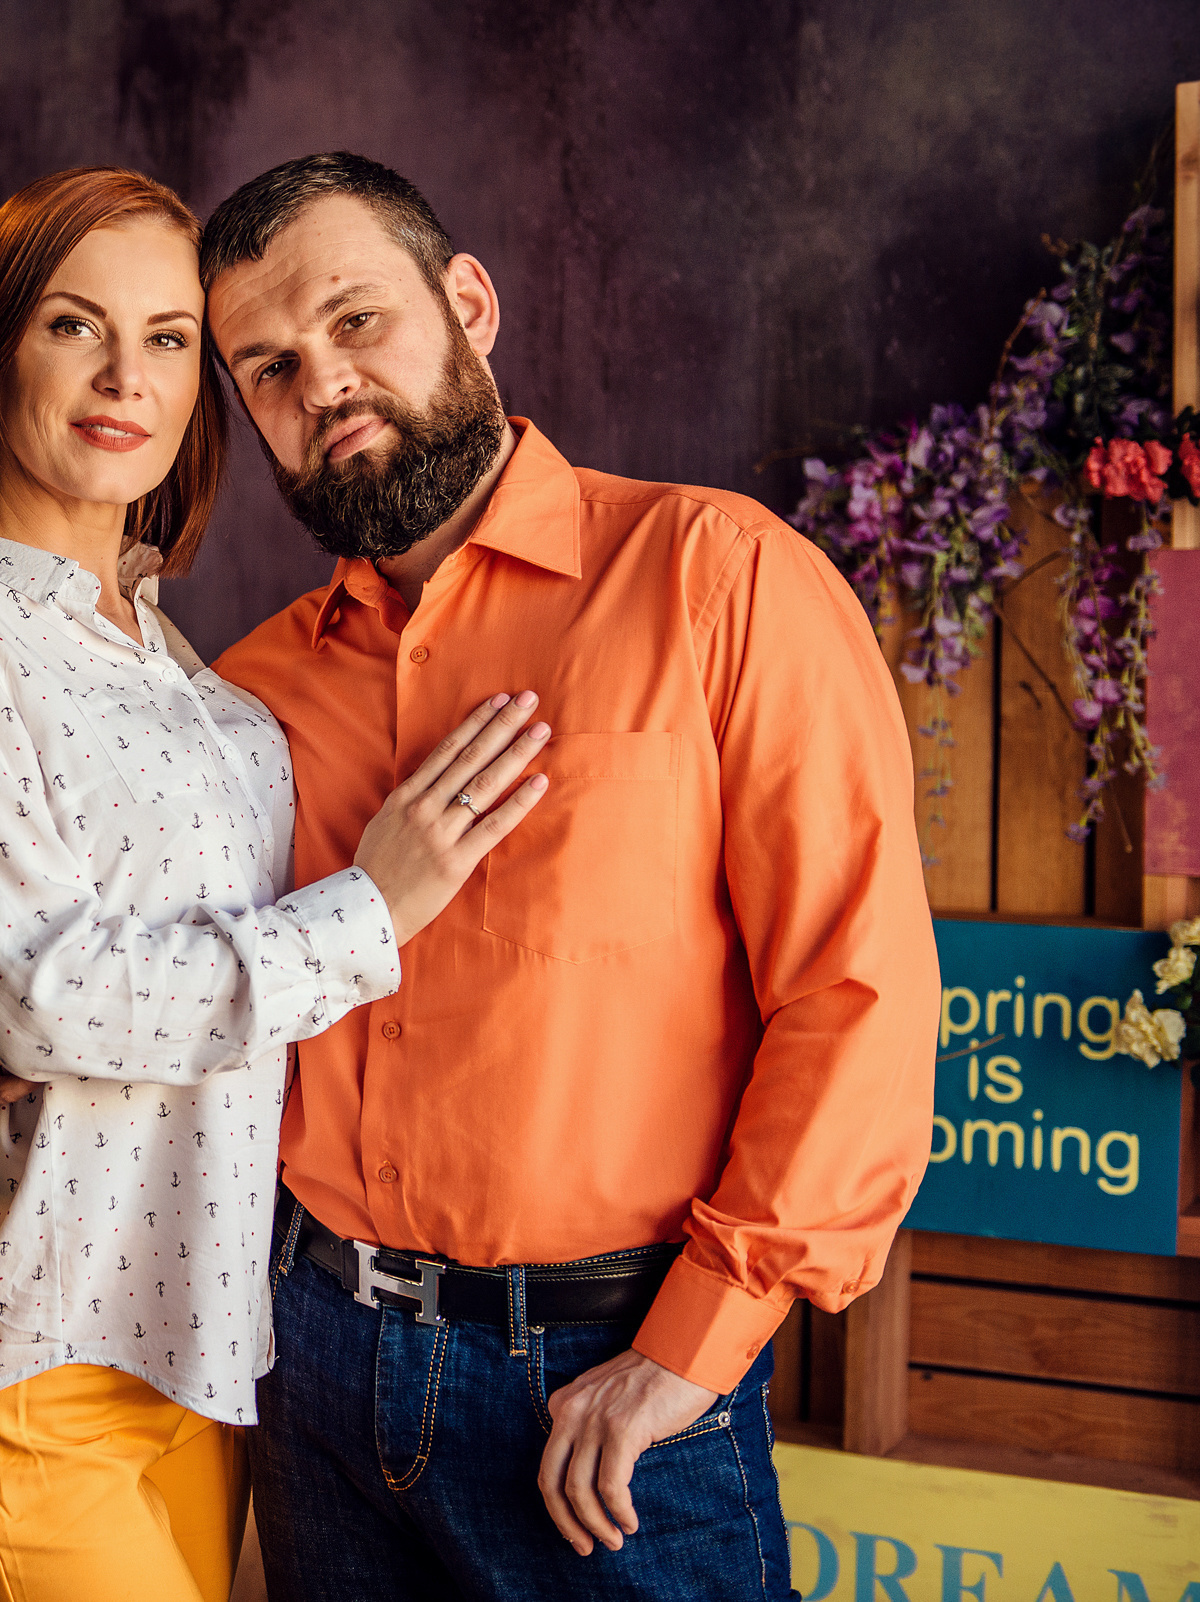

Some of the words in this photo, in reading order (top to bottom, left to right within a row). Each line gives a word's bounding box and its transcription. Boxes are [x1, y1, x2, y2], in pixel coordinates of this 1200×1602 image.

[940, 975, 1121, 1061] pring
[967, 1038, 1024, 1104] is
[928, 1108, 1140, 1196] oming
